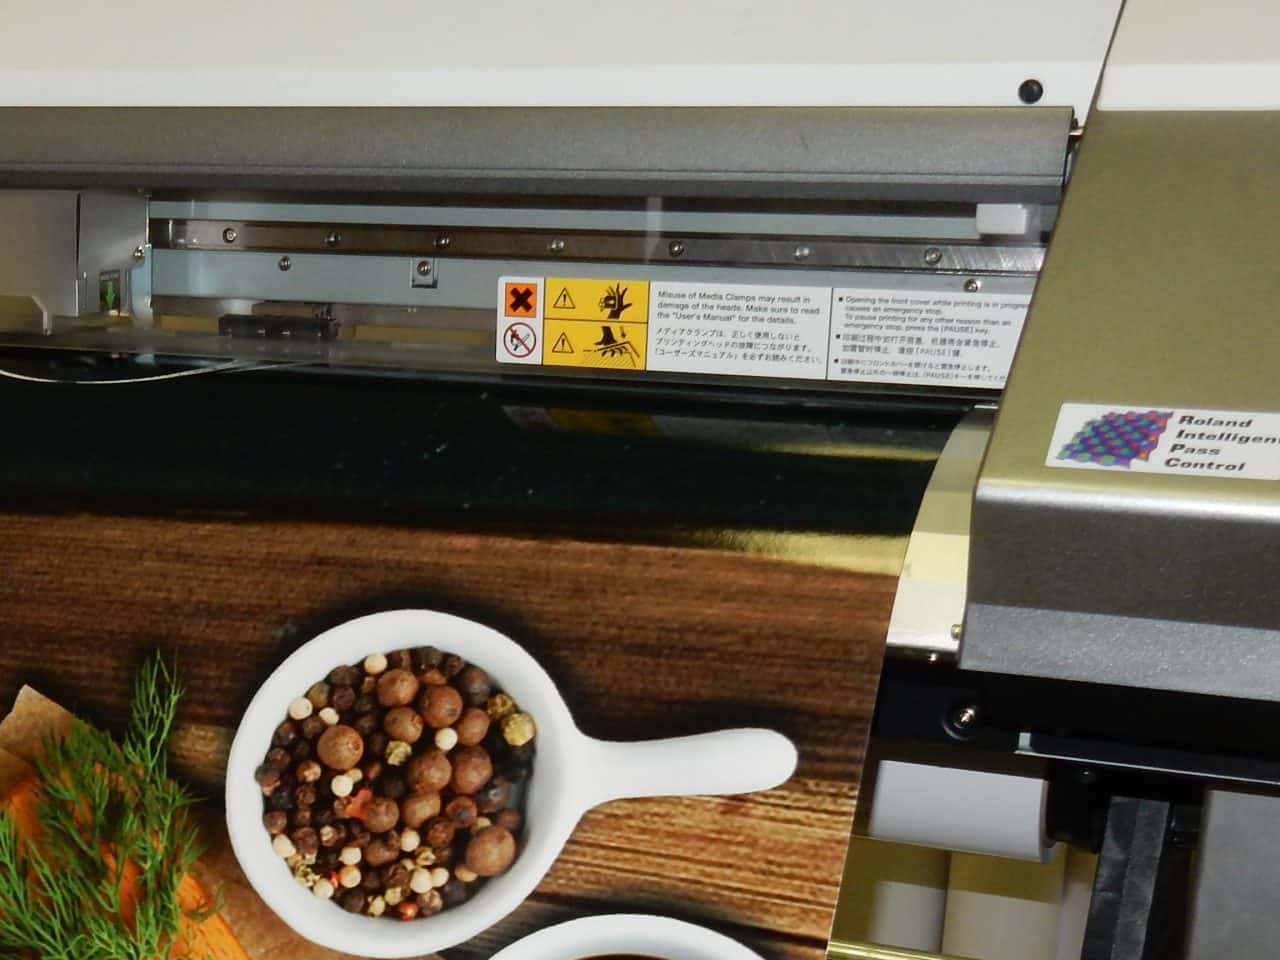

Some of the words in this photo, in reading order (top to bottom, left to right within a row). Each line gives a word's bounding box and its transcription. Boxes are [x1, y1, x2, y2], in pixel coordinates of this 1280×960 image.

[658, 290, 686, 299] Misuse
[688, 291, 697, 300] of
[698, 292, 723, 301] Media
[724, 293, 756, 303] Clamps
[758, 295, 776, 304] may
[777, 295, 802, 304] result
[802, 296, 811, 304] in
[846, 296, 875, 304] Opening
[953, 300, 982, 309] printing
[657, 301, 689, 311] damage
[691, 302, 700, 310] of
[701, 302, 714, 311] the
[716, 303, 743, 312] heads.
[745, 304, 768, 313] Make
[770, 305, 788, 314] sure
[790, 306, 799, 314] to
[800, 306, 820, 315] read
[657, 311, 670, 320] the
[738, 314, 750, 322] for
[751, 315, 764, 323] the
[878, 314, 906, 323] printing
[1177, 414, 1254, 429] Roland
[1169, 443, 1221, 457] Pass
[1163, 457, 1246, 472] Control
